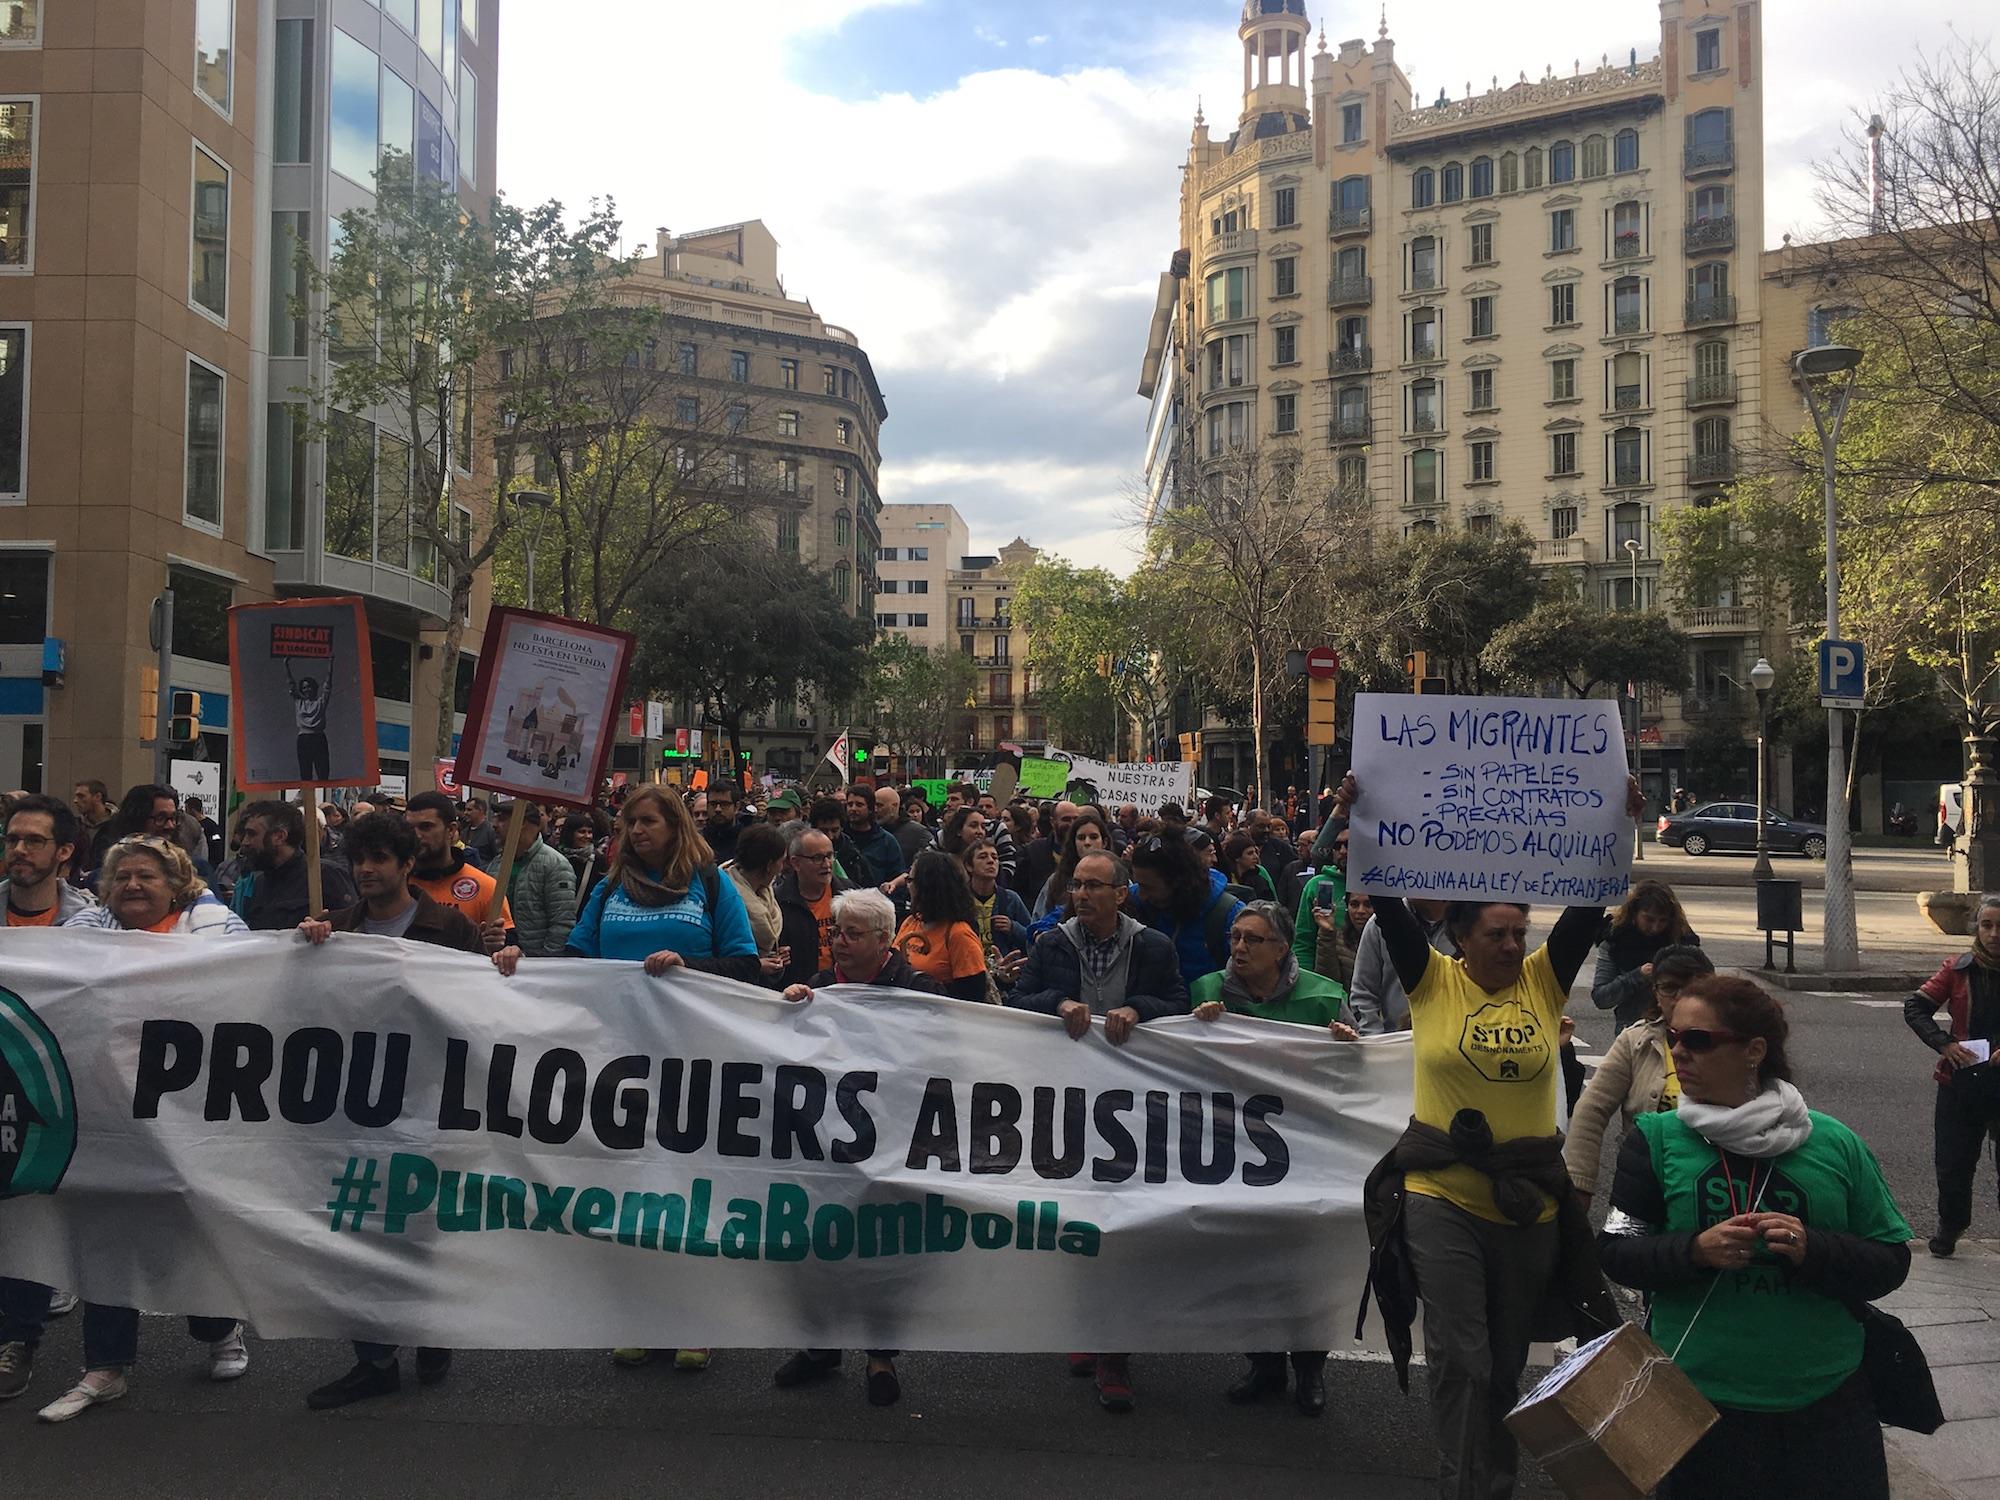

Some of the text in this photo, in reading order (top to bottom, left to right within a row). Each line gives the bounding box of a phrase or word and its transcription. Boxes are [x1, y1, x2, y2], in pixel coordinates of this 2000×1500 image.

[274, 626, 330, 641] SINDICAT
[533, 633, 593, 654] BARCELONA
[513, 641, 530, 651] NO
[556, 651, 571, 661] EN
[573, 654, 607, 670] VENDA
[1829, 646, 1856, 690] P
[1380, 713, 1437, 748] LAS
[1108, 771, 1175, 787] NUESTRAS
[1481, 761, 1580, 786] PAPELES
[1100, 788, 1185, 807] CASAS NO SON
[1483, 787, 1604, 811] CONTRATOS
[1378, 820, 1416, 848] NO
[1472, 1024, 1536, 1045] STOP
[133, 1019, 1291, 1187] PROU LLOGUERS ABUSIUS
[326, 1152, 1101, 1263] #PunxemLaBombolla
